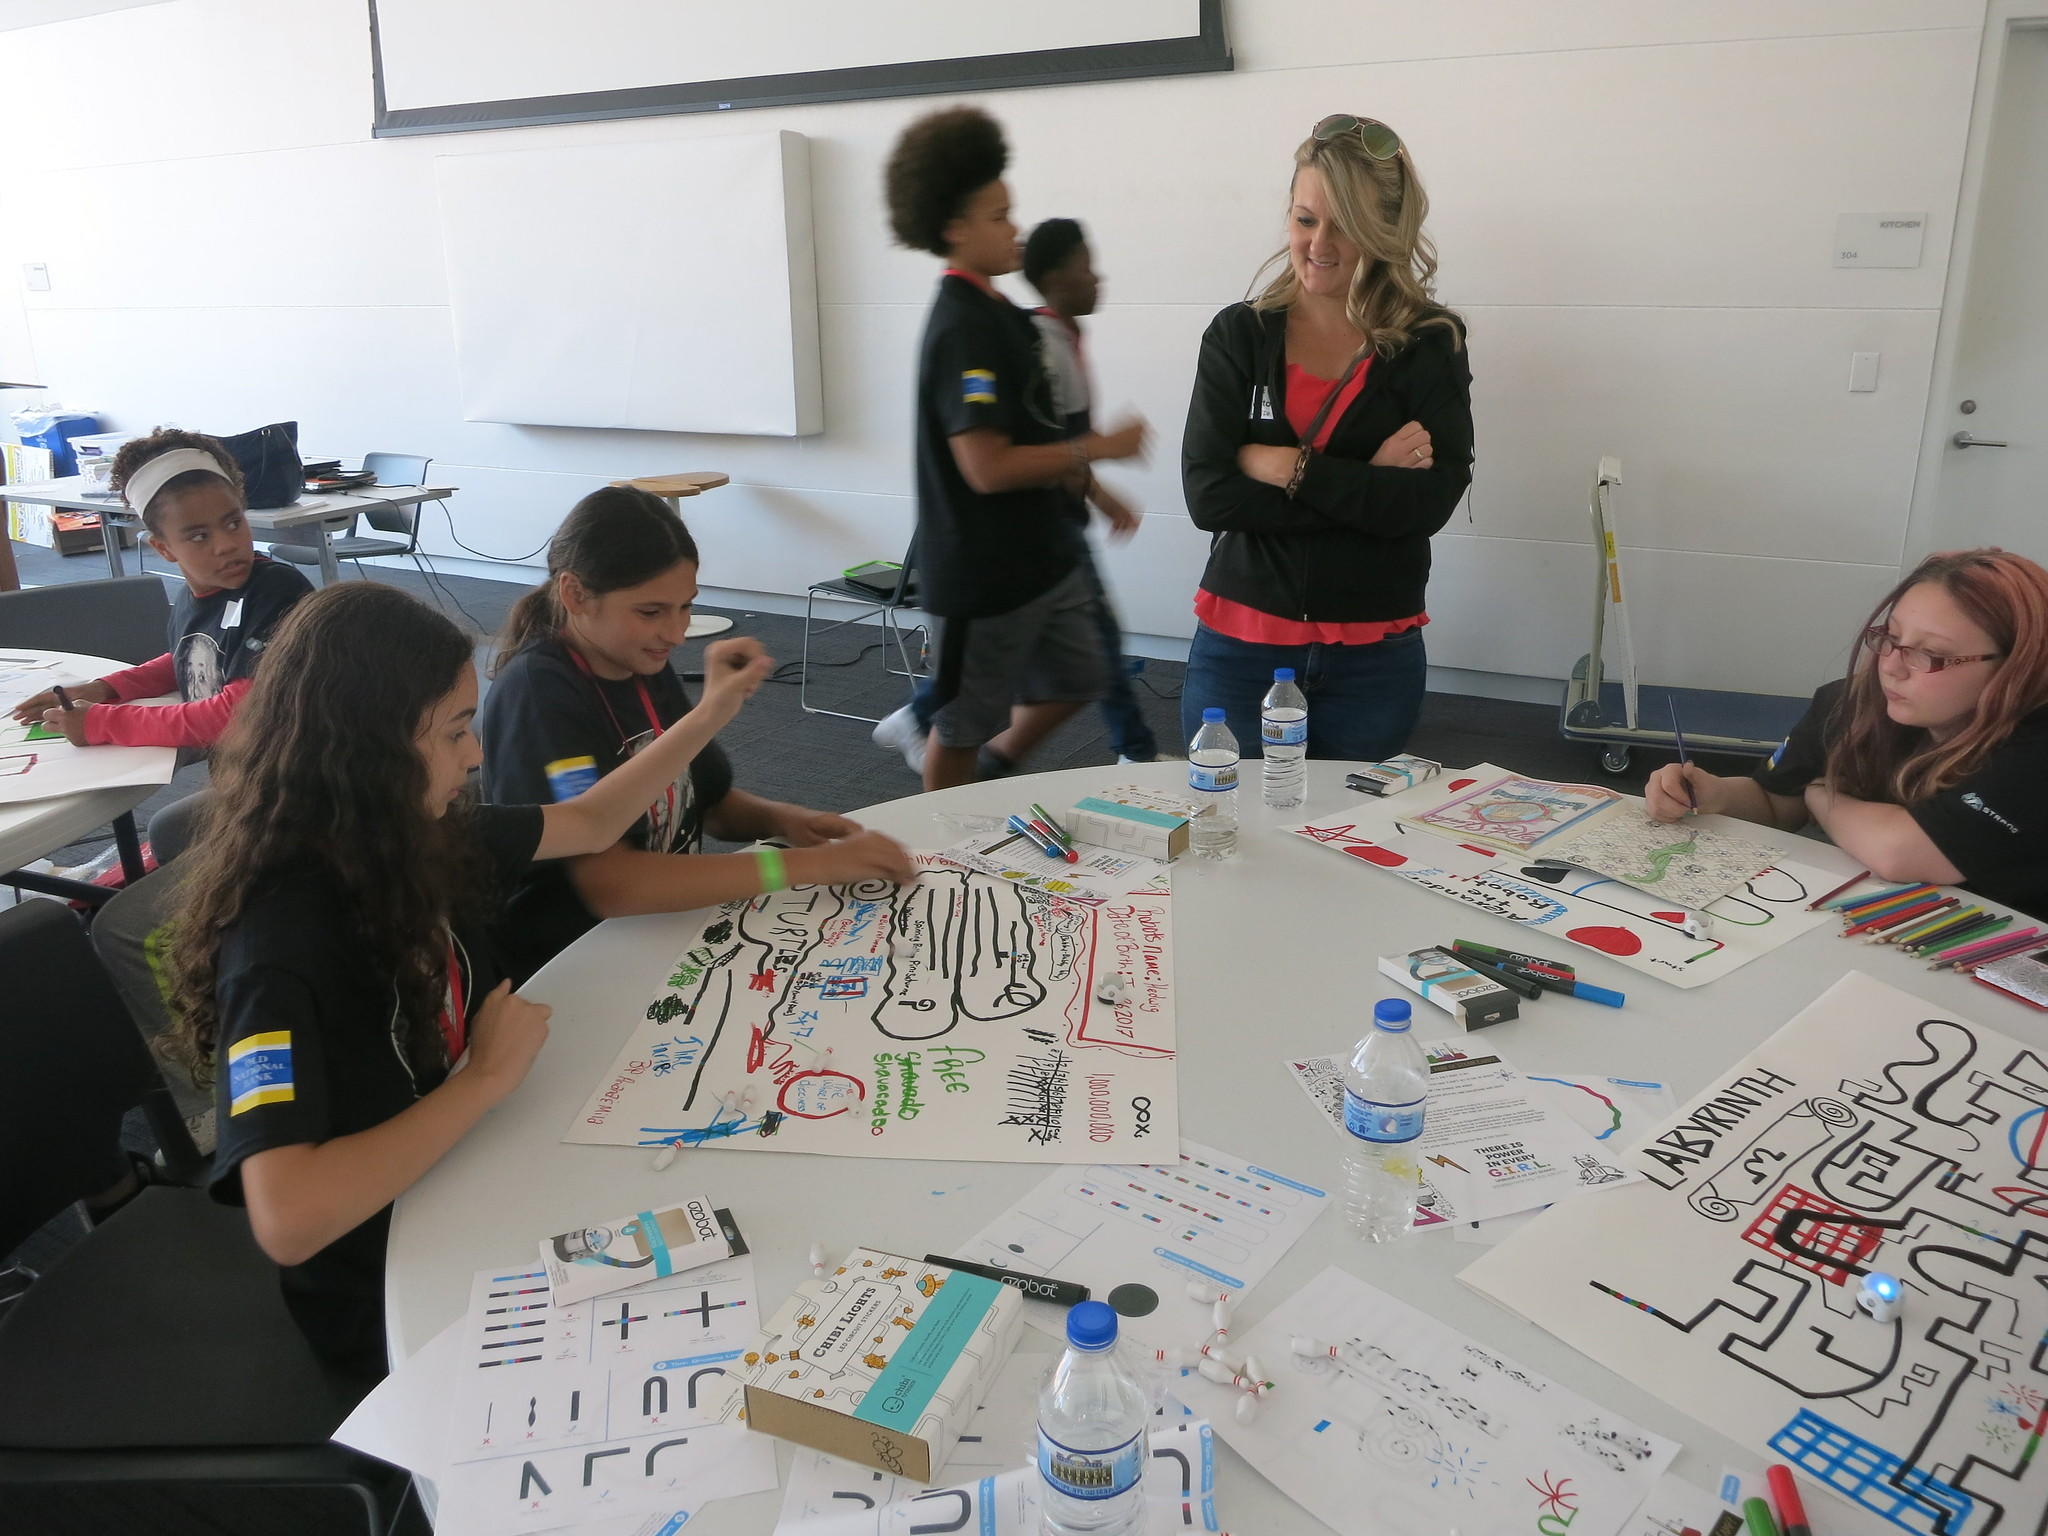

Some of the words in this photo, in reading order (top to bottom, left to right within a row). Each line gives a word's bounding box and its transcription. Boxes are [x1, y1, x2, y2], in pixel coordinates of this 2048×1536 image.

[1880, 221, 1921, 229] KITCHEN
[1840, 251, 1858, 259] 304
[1404, 875, 1528, 922] Alexander
[1467, 888, 1510, 908] the
[1475, 878, 1552, 909] Robot
[769, 892, 819, 973] TURTLES
[1117, 930, 1135, 943] of
[1140, 983, 1168, 1013] Hedwig
[1452, 983, 1499, 998] ozobot
[831, 1082, 848, 1099] The
[1638, 1066, 1800, 1191] LABYRINTH
[1473, 1143, 1509, 1155] THERE
[1509, 1141, 1524, 1149] IS
[1484, 1148, 1525, 1160] POWER
[1485, 1160, 1502, 1168] IN
[1501, 1154, 1537, 1166] EVERY
[1488, 1160, 1551, 1178] G.I.R.L.
[687, 1200, 718, 1241] ozobot
[1000, 1275, 1059, 1299] ozobot
[813, 1317, 846, 1359] CHIBI
[839, 1286, 876, 1326] LIGHTS
[837, 1340, 848, 1353] LED
[845, 1320, 863, 1344] CIRCUIT
[859, 1299, 882, 1326] STICKERS
[894, 1375, 911, 1397] chibi
